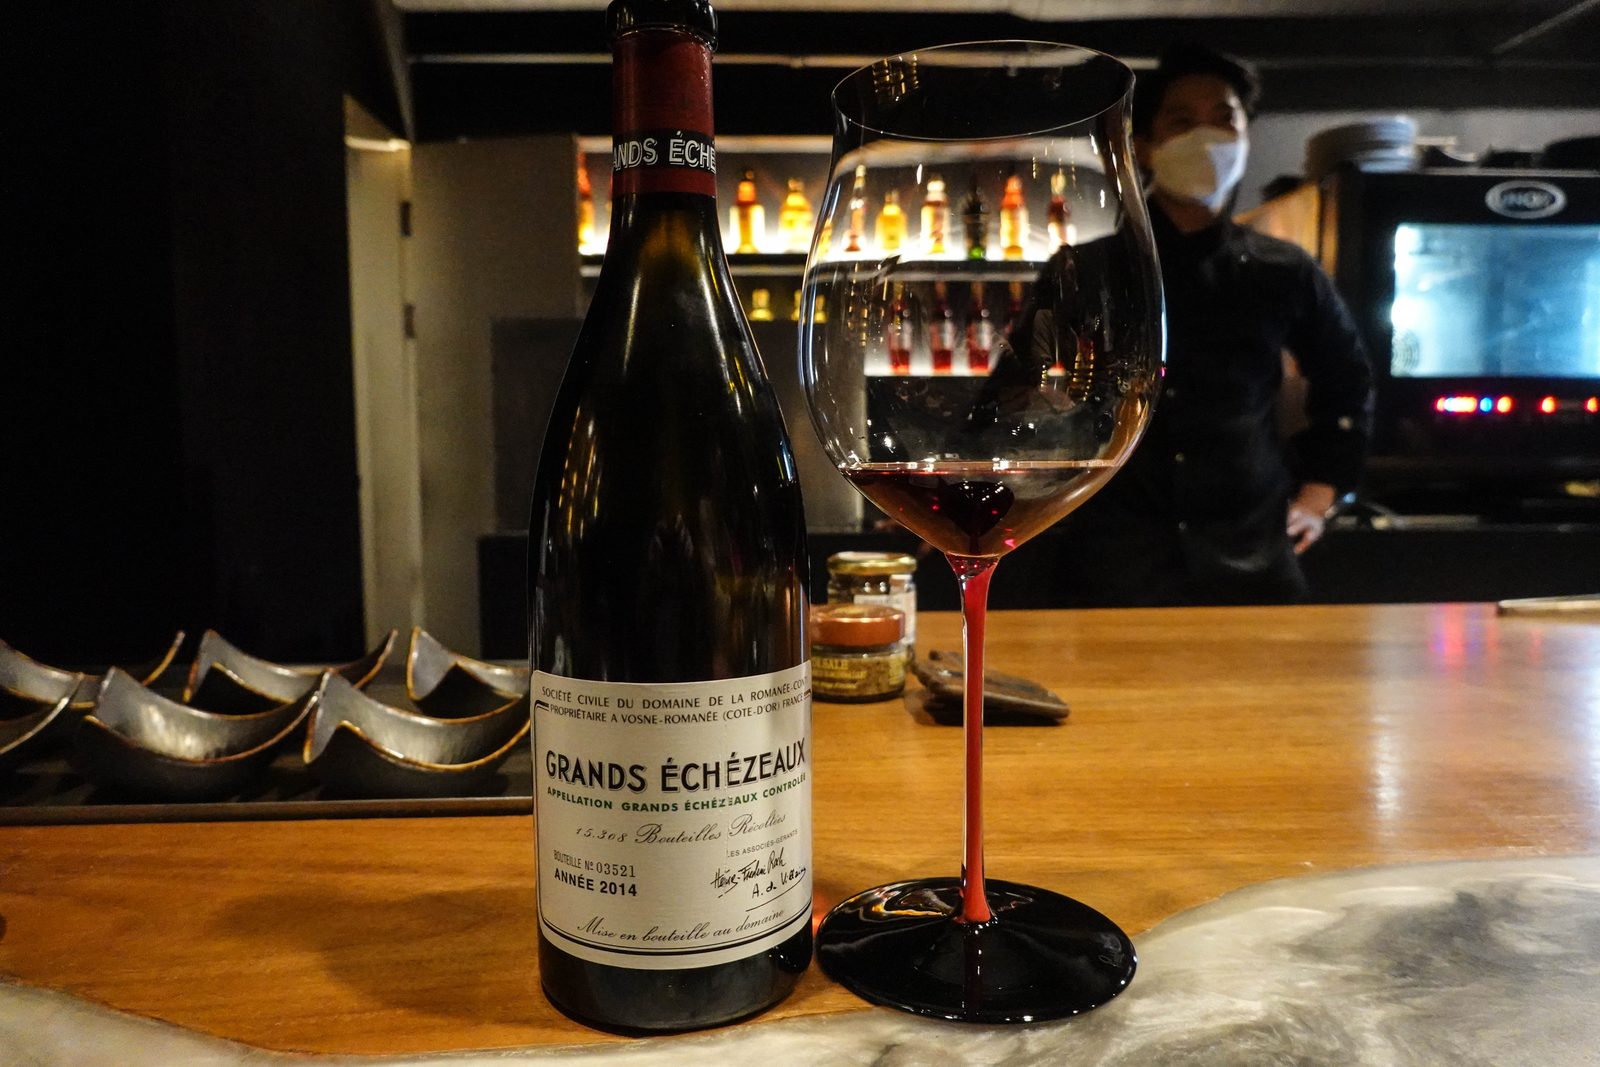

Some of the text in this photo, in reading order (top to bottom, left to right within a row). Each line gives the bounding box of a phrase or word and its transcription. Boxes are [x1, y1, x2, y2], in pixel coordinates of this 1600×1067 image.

[541, 686, 572, 703] SOCIÉTÉ
[577, 694, 610, 708] CIVILE
[617, 698, 634, 709] DU
[642, 698, 701, 710] DOMAINE
[708, 695, 724, 707] DE
[731, 692, 744, 704] LA
[550, 704, 606, 722] PROPRIÉTAIRE
[610, 714, 618, 723] A
[621, 710, 719, 725] VOSNE-ROMANÉE
[782, 694, 803, 709] FRANCE
[546, 738, 806, 794] GRANDS ÉCHÉZEAUX
[547, 785, 613, 810] APPELLATION
[621, 801, 679, 812] GRANDS
[684, 792, 758, 811] ÉCHÉZEAUX
[634, 822, 722, 845] Bouteilles
[553, 849, 582, 869] BOUTEILLE
[596, 862, 637, 878] 03521
[554, 868, 637, 897] ANNÉE 2014
[577, 908, 785, 943] Mise en bouteille au domaine
